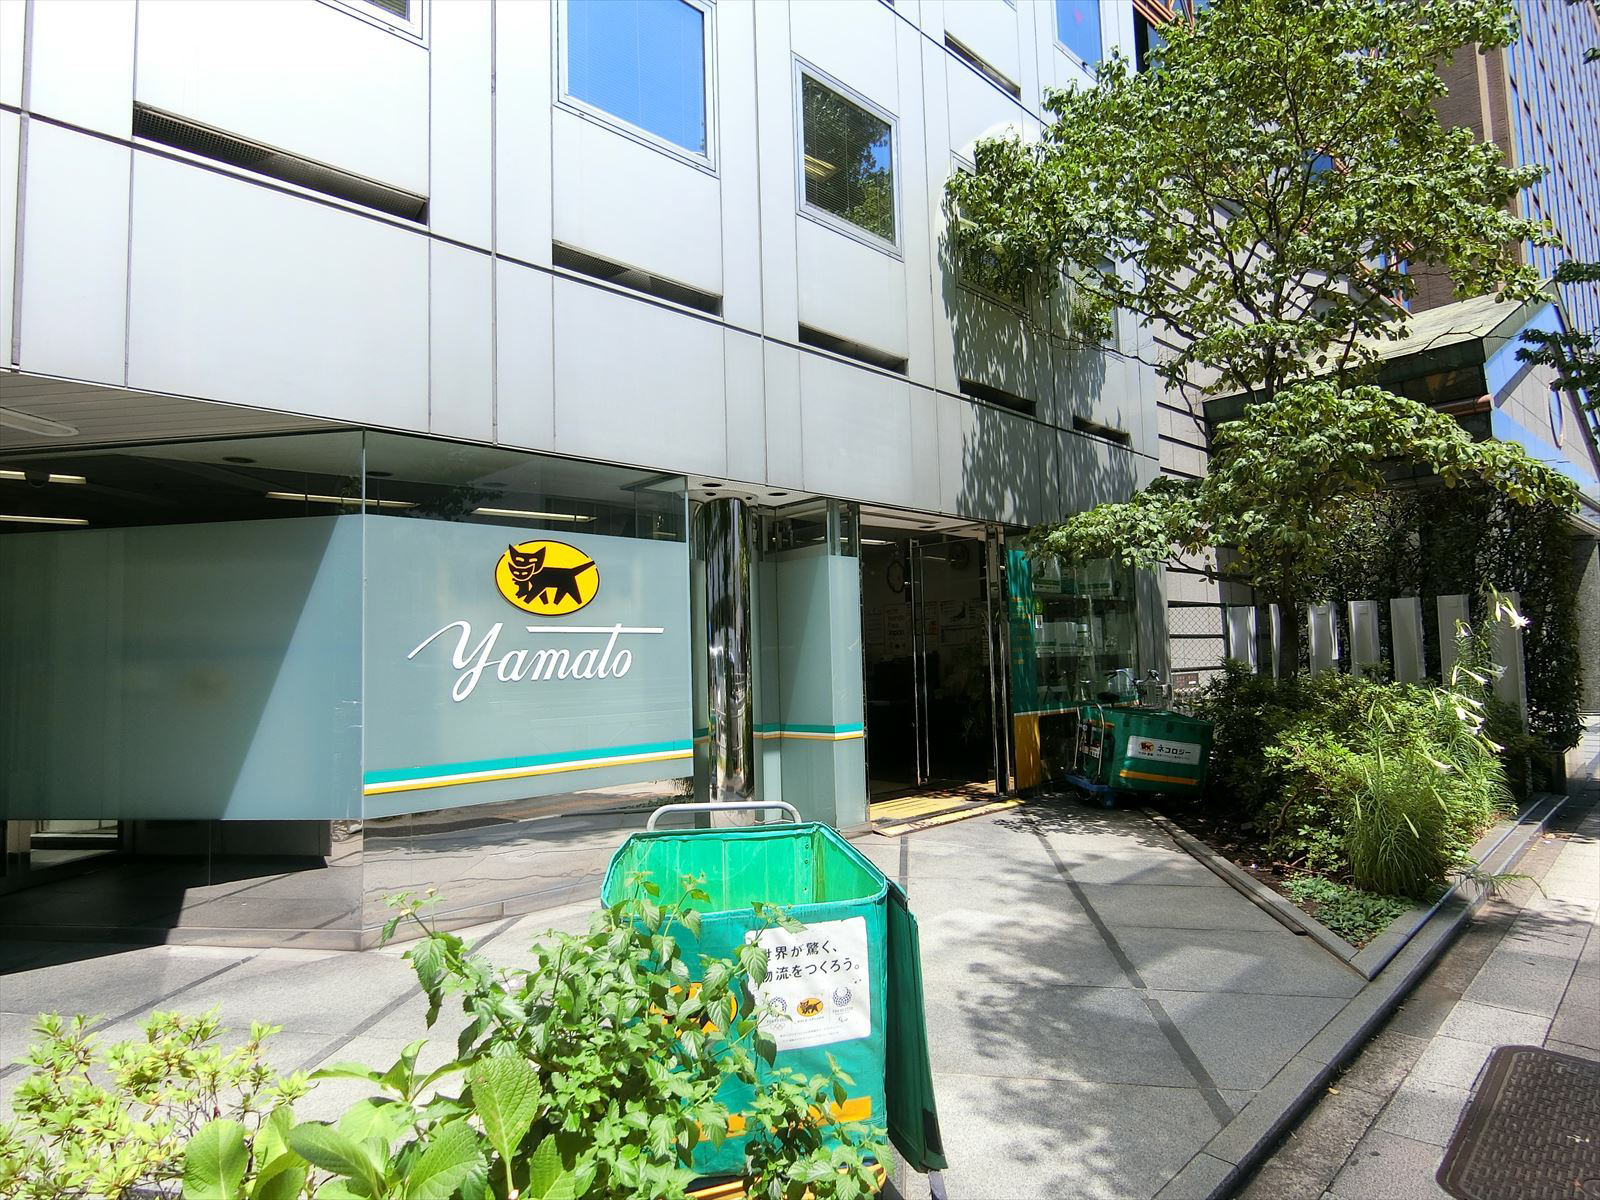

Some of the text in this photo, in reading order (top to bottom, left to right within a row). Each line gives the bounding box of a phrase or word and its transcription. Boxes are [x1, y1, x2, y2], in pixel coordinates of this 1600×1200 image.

[407, 620, 665, 702] Yamato
[1157, 744, 1192, 756] ネコロジー
